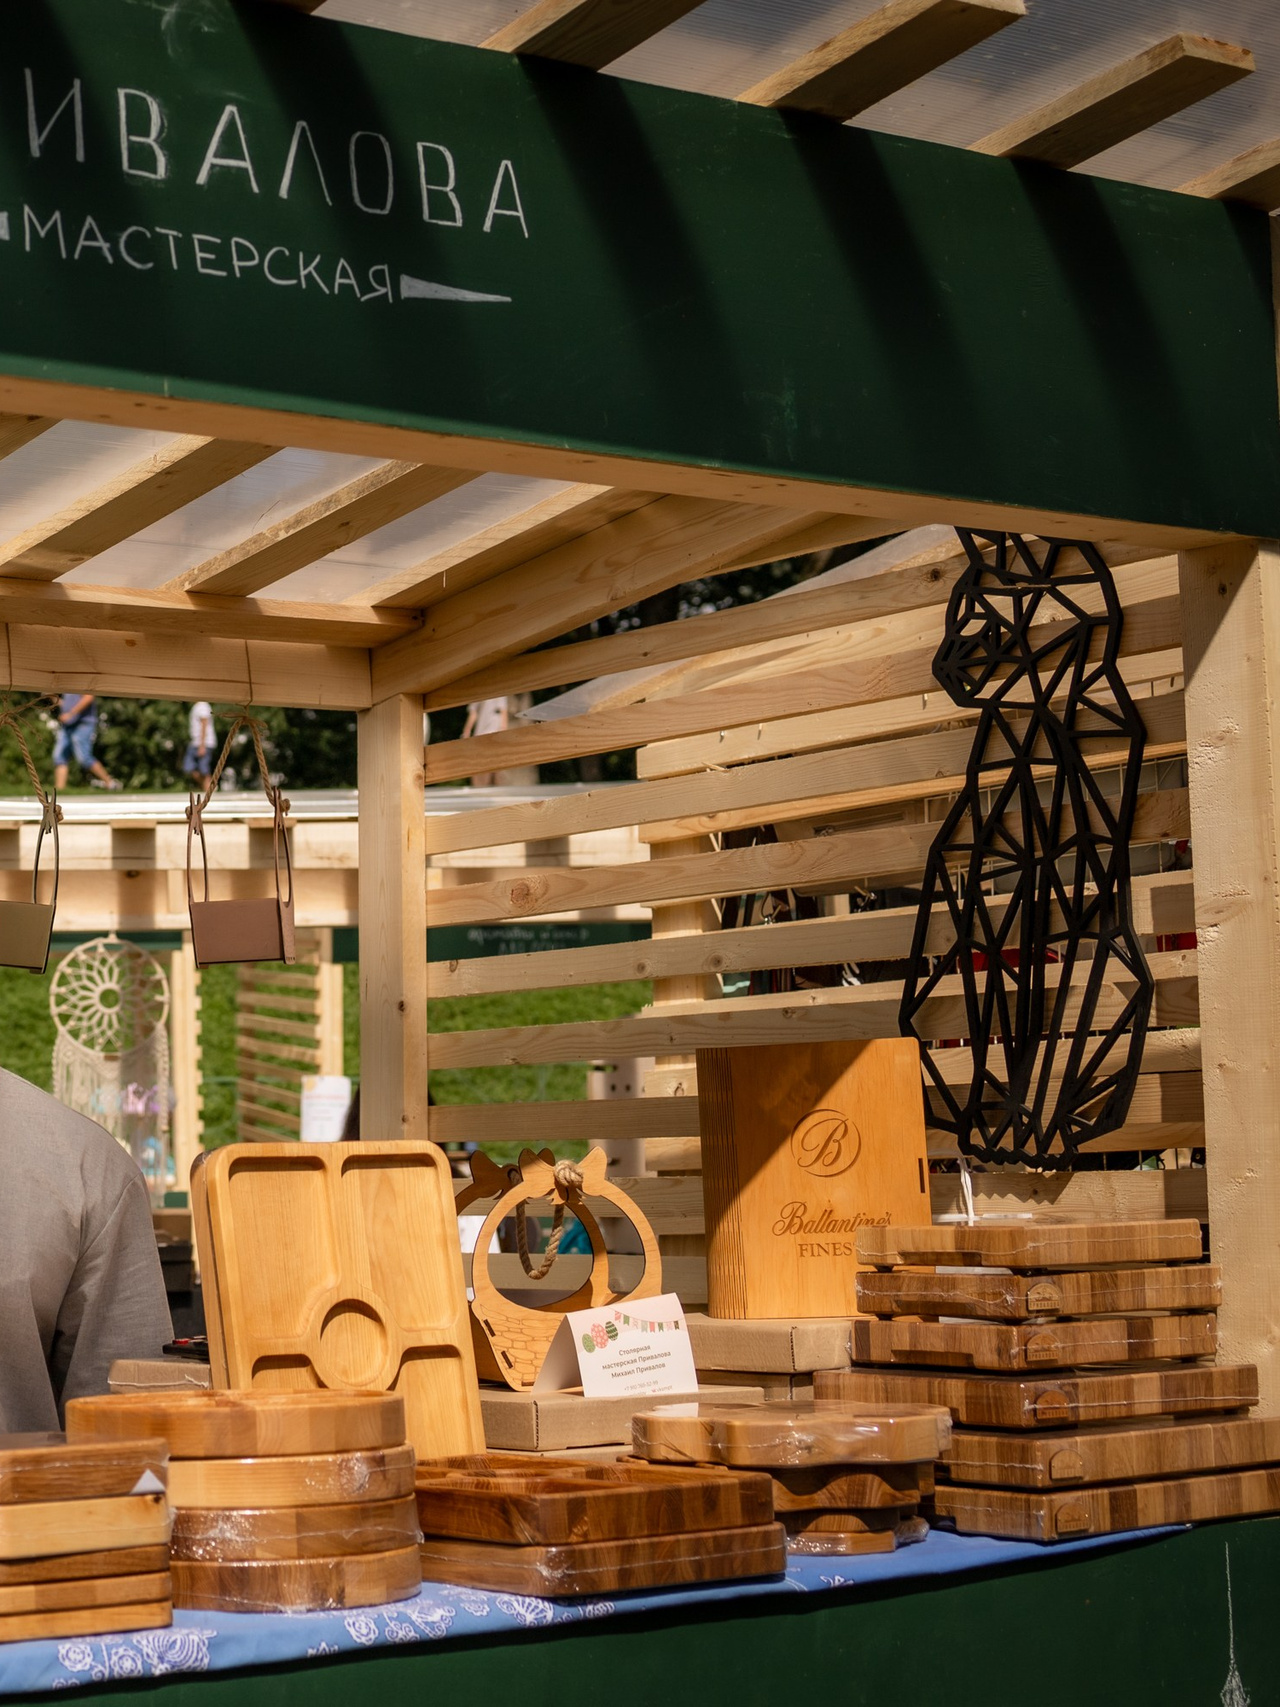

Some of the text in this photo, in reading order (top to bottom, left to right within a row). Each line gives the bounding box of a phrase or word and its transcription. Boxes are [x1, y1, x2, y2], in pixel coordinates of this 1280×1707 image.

[23, 203, 393, 303] МАСТЕРСКАЯ
[798, 1243, 855, 1258] FINES
[619, 1345, 651, 1356] Столярная
[602, 1351, 671, 1370] мастерская Привалова
[611, 1362, 666, 1379] Михаил Привалов
